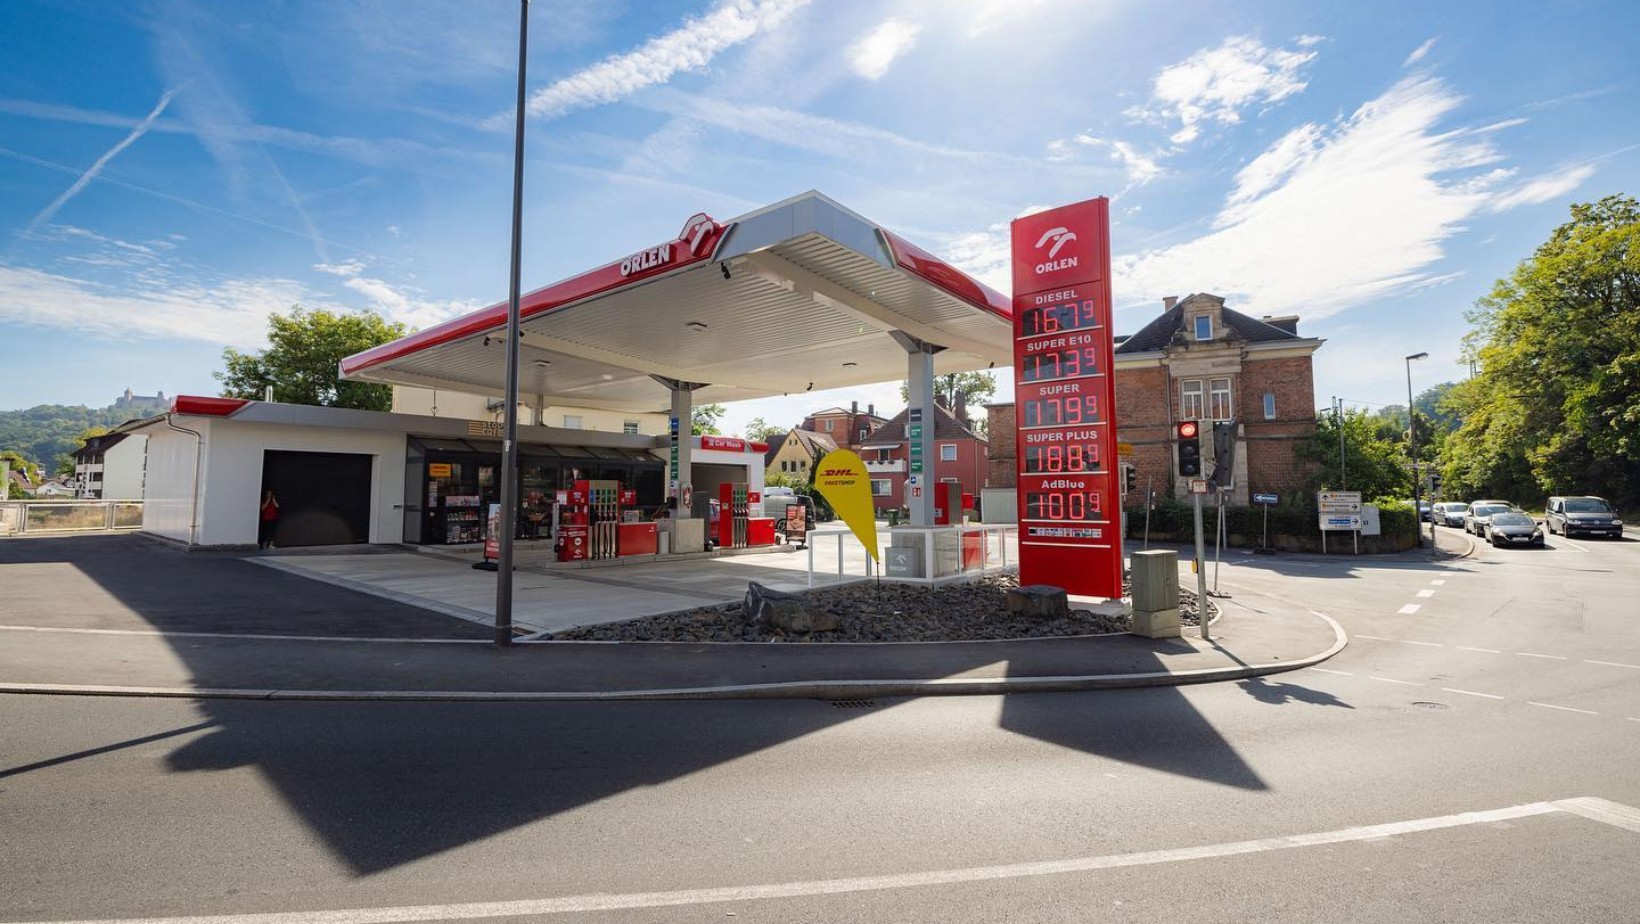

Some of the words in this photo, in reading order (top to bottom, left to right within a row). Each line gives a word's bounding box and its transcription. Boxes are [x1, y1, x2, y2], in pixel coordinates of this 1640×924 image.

[620, 243, 670, 276] ORLEN
[1035, 256, 1078, 274] ORLEN
[1035, 289, 1078, 305] DIESEL
[1027, 338, 1066, 351] SUPER
[1069, 334, 1091, 346] E10
[1040, 384, 1080, 396] SUPER
[1027, 432, 1063, 443] SUPER
[1066, 430, 1098, 440] PLUS
[1041, 479, 1085, 489] AdBlue
